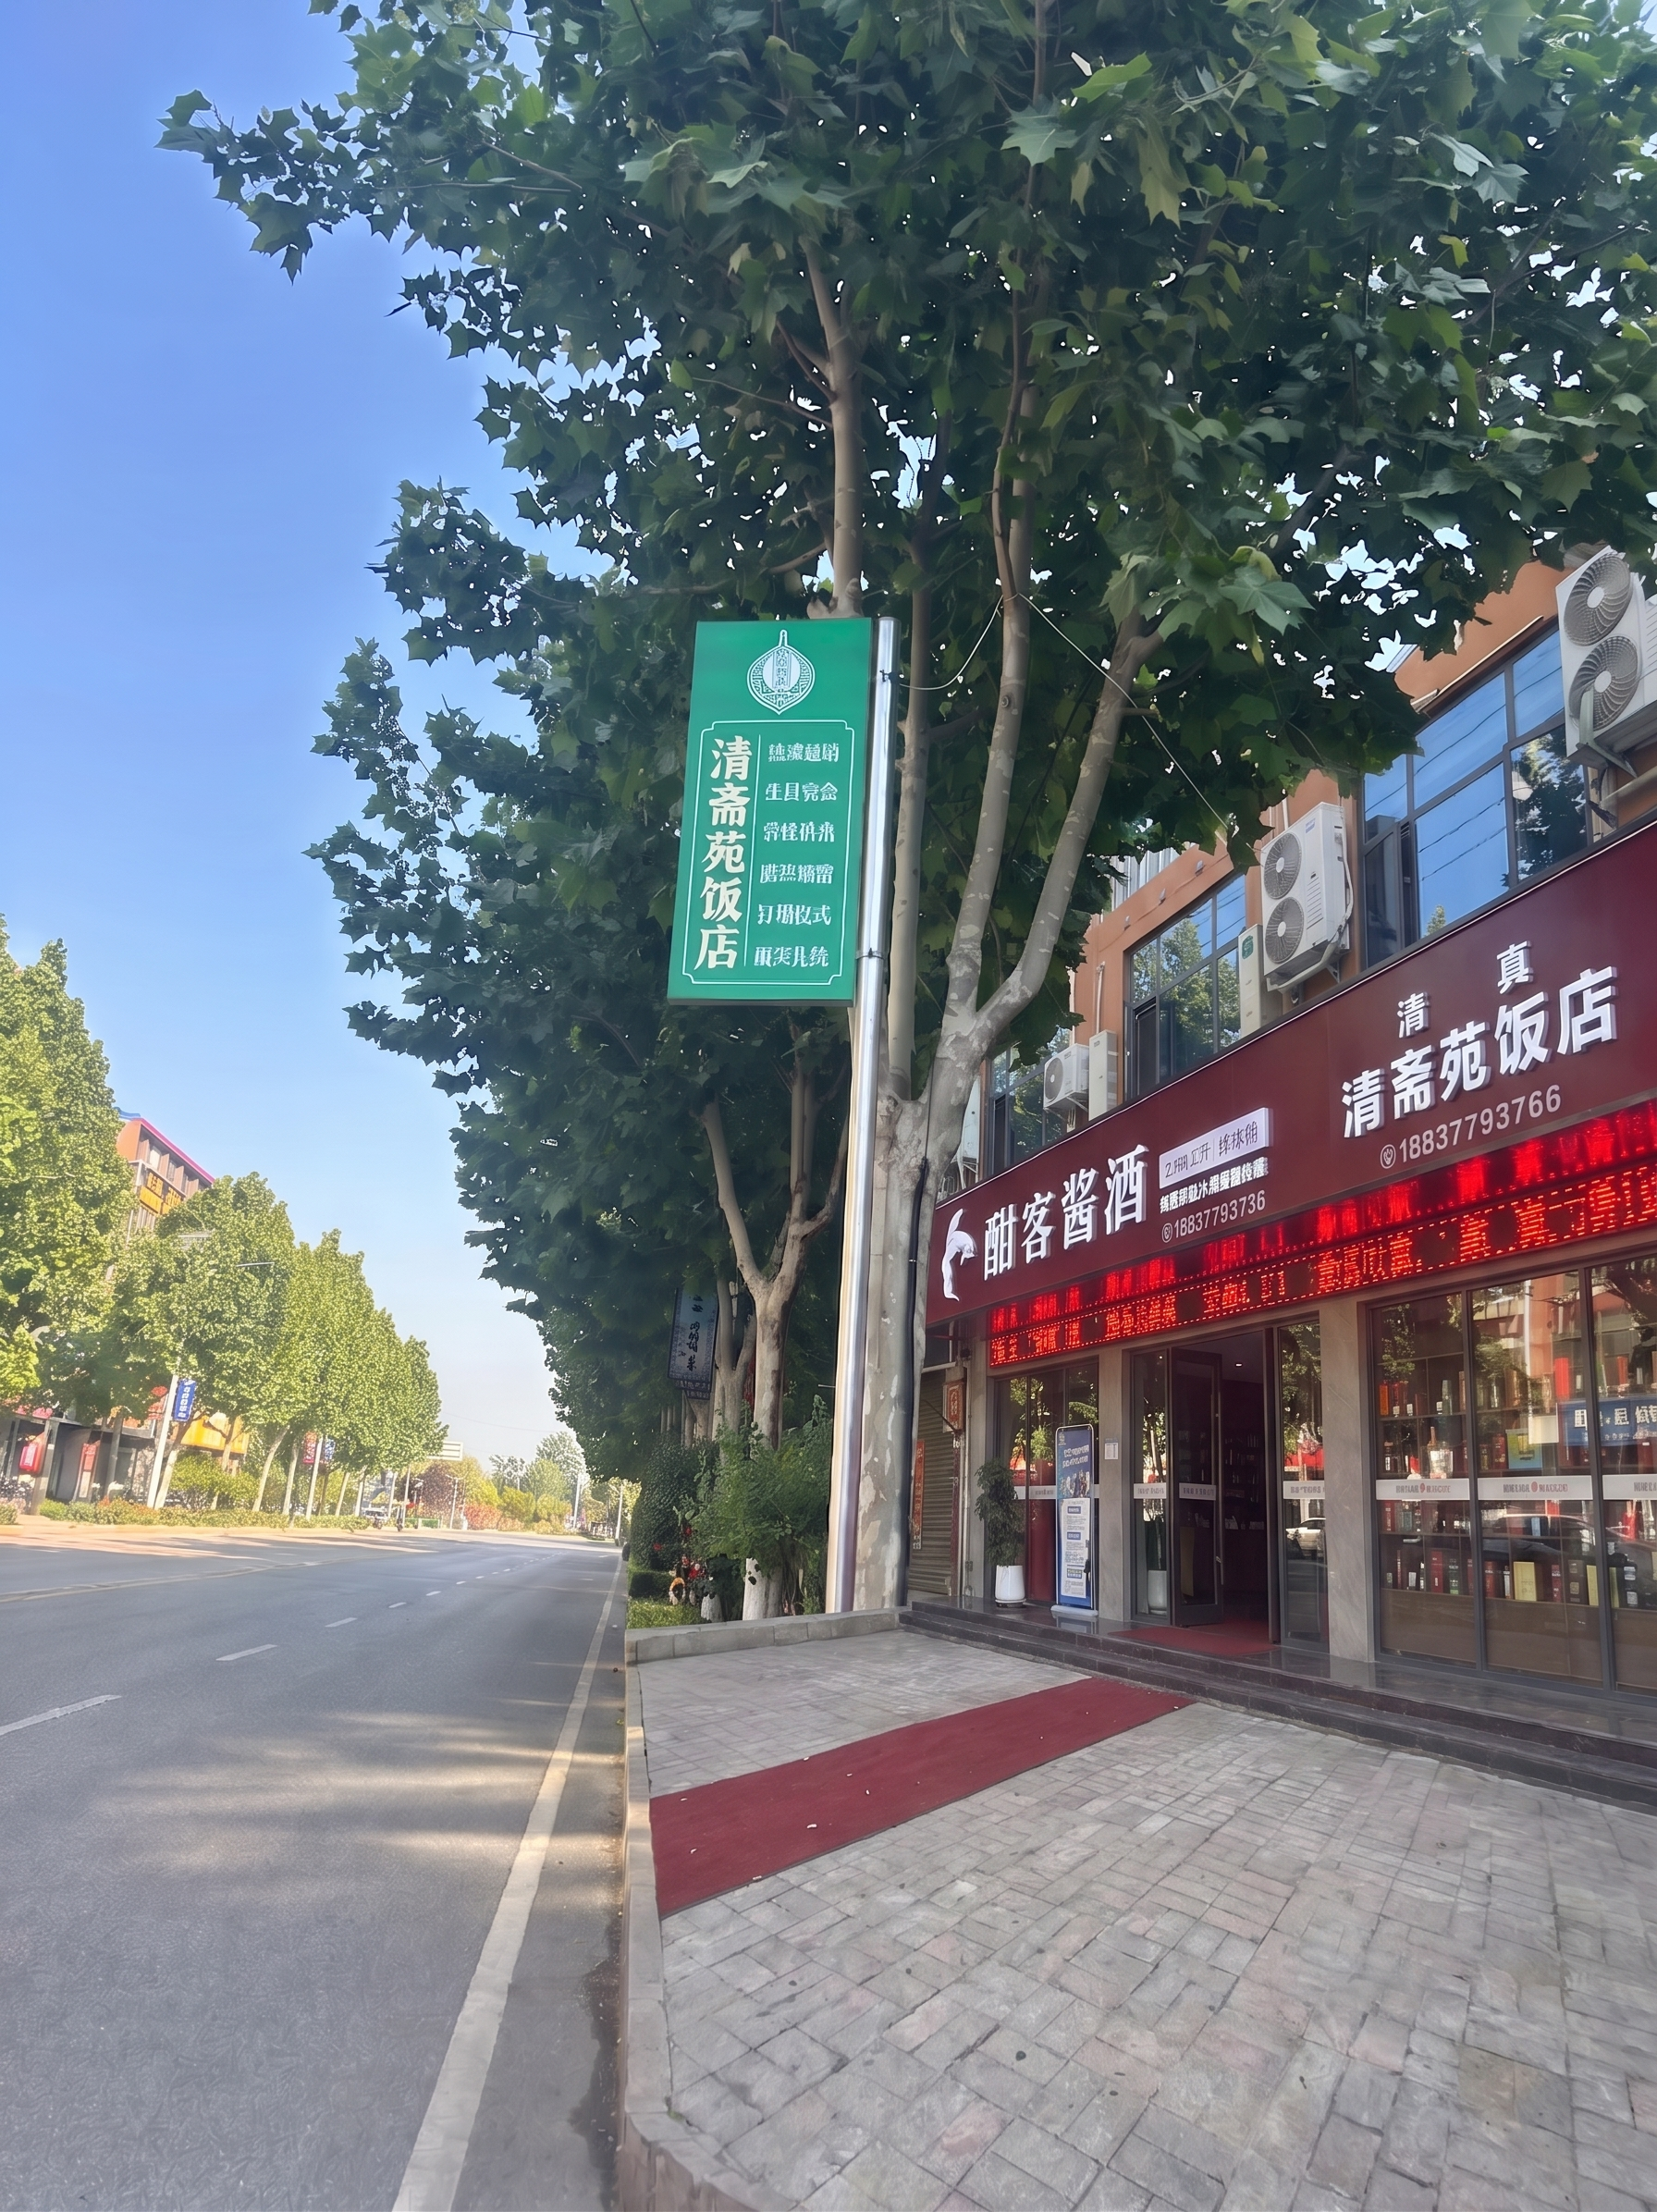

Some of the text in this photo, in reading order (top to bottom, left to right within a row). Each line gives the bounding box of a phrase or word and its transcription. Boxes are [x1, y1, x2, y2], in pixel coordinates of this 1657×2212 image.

[693, 735, 753, 970] 清斋苑饭店
[1341, 966, 1617, 1137] 清斋苑饭店
[1399, 1084, 1562, 1162] 18837793766
[984, 1144, 1150, 1281] 酣客酱酒
[1174, 1189, 1266, 1238] 18837793736
